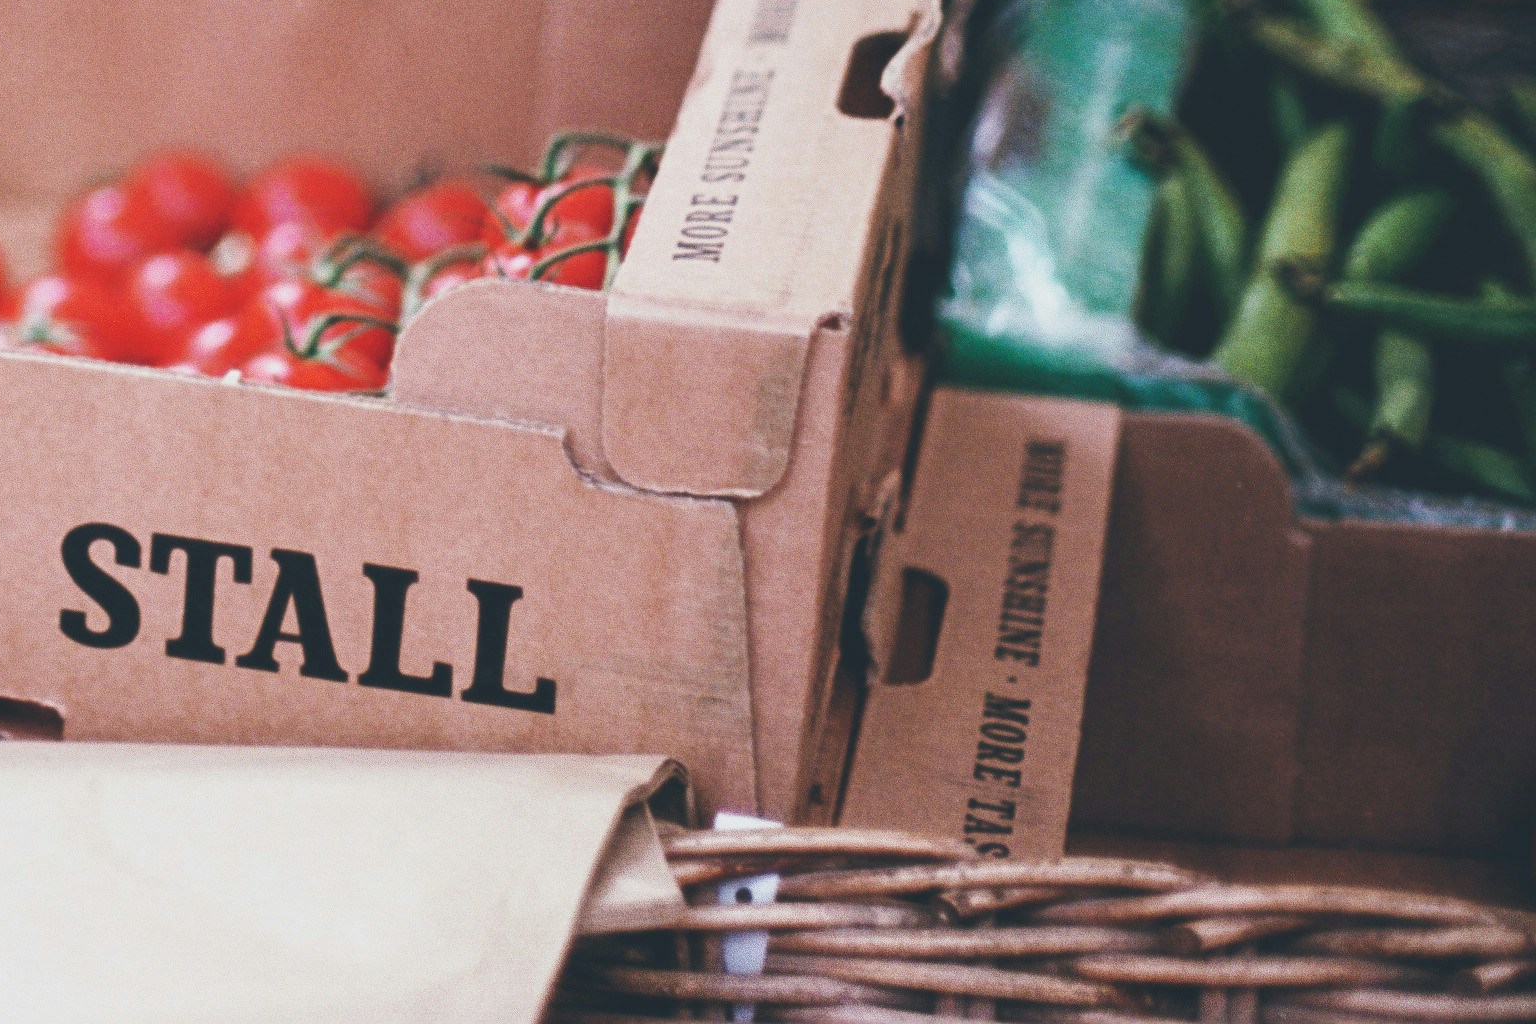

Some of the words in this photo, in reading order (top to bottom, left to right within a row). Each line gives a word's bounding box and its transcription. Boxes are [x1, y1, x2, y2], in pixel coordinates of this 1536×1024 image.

[702, 69, 775, 183] SUNSHINE
[672, 193, 738, 263] MORE
[59, 522, 556, 714] STALL
[994, 520, 1056, 668] SUNSHINE
[973, 691, 1032, 788] MORE
[963, 796, 1017, 859] TAS
